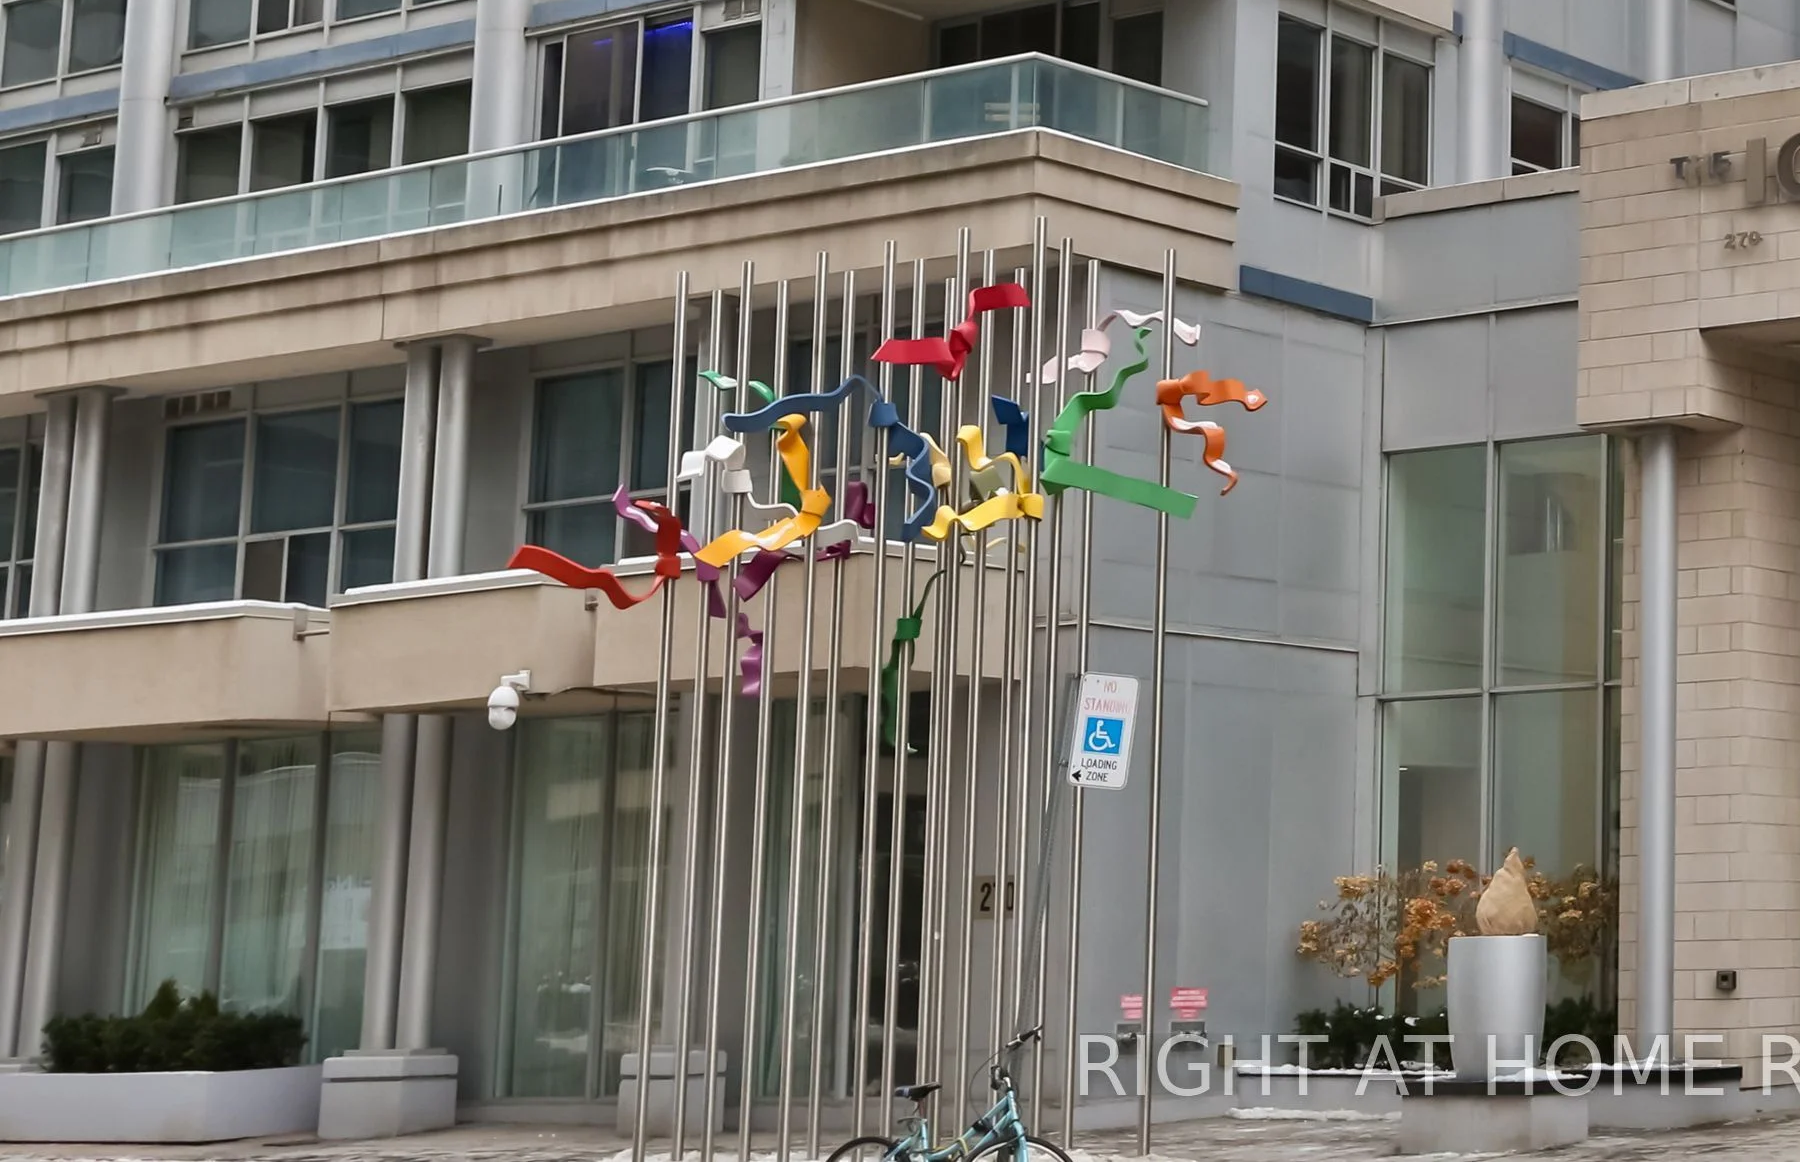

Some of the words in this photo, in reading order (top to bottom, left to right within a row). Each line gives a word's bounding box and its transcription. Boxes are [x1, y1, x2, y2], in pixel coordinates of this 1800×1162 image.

[1723, 230, 1763, 249] 270
[1103, 680, 1117, 694] NO
[1084, 697, 1132, 714] STANDIN
[1080, 757, 1118, 770] LOADING
[1086, 770, 1109, 783] ZONE
[980, 881, 1015, 912] 20
